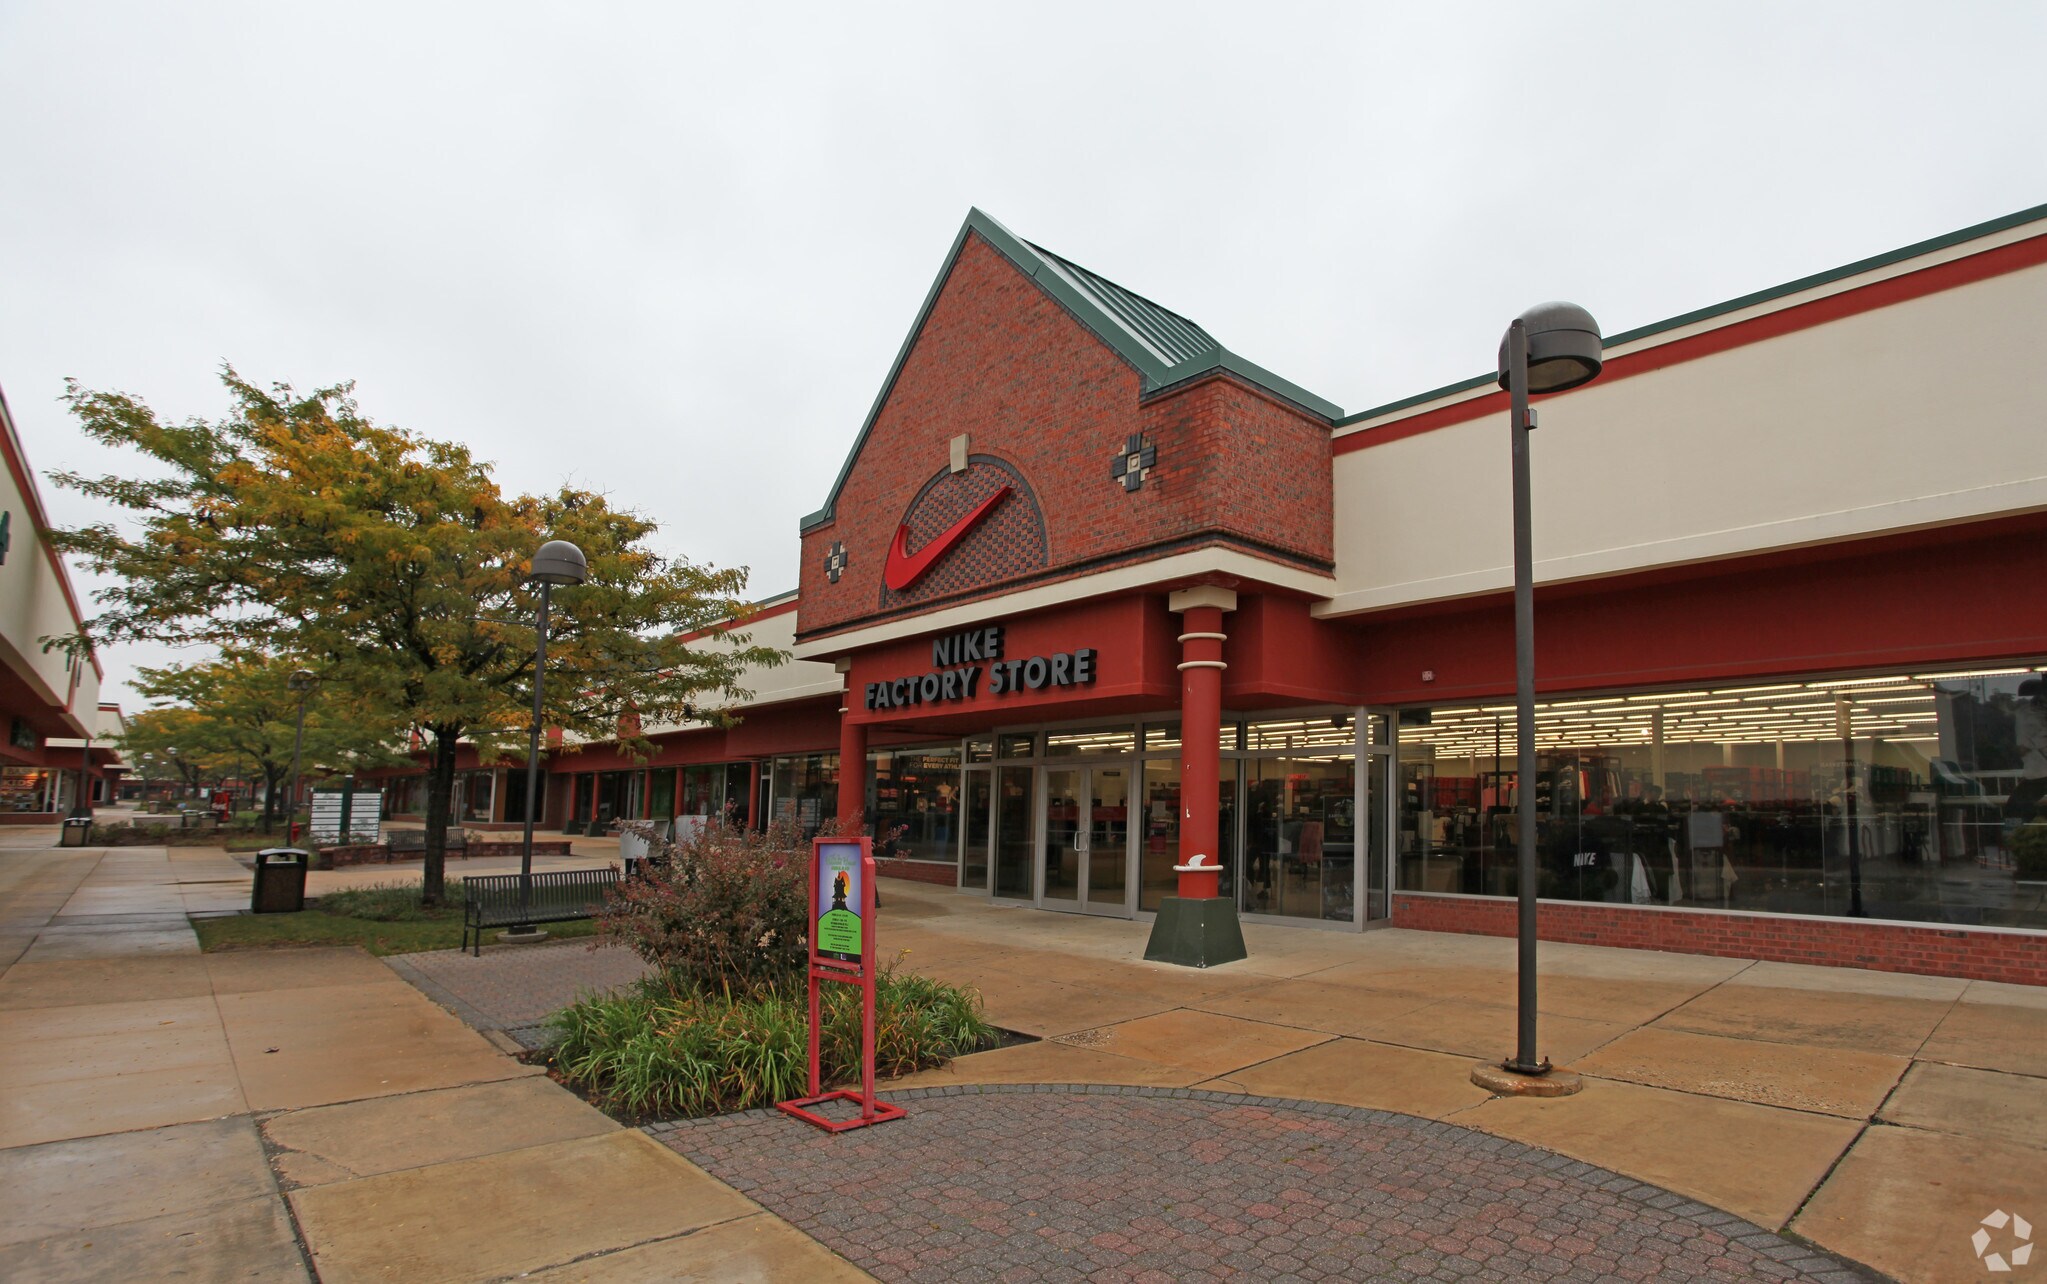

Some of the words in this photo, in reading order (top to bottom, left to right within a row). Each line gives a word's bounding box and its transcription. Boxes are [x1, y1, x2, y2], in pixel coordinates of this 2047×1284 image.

[932, 627, 1002, 667] NIKE
[864, 666, 980, 709] FACTORY
[989, 648, 1096, 694] STORE
[1573, 852, 1596, 867] NIKE
